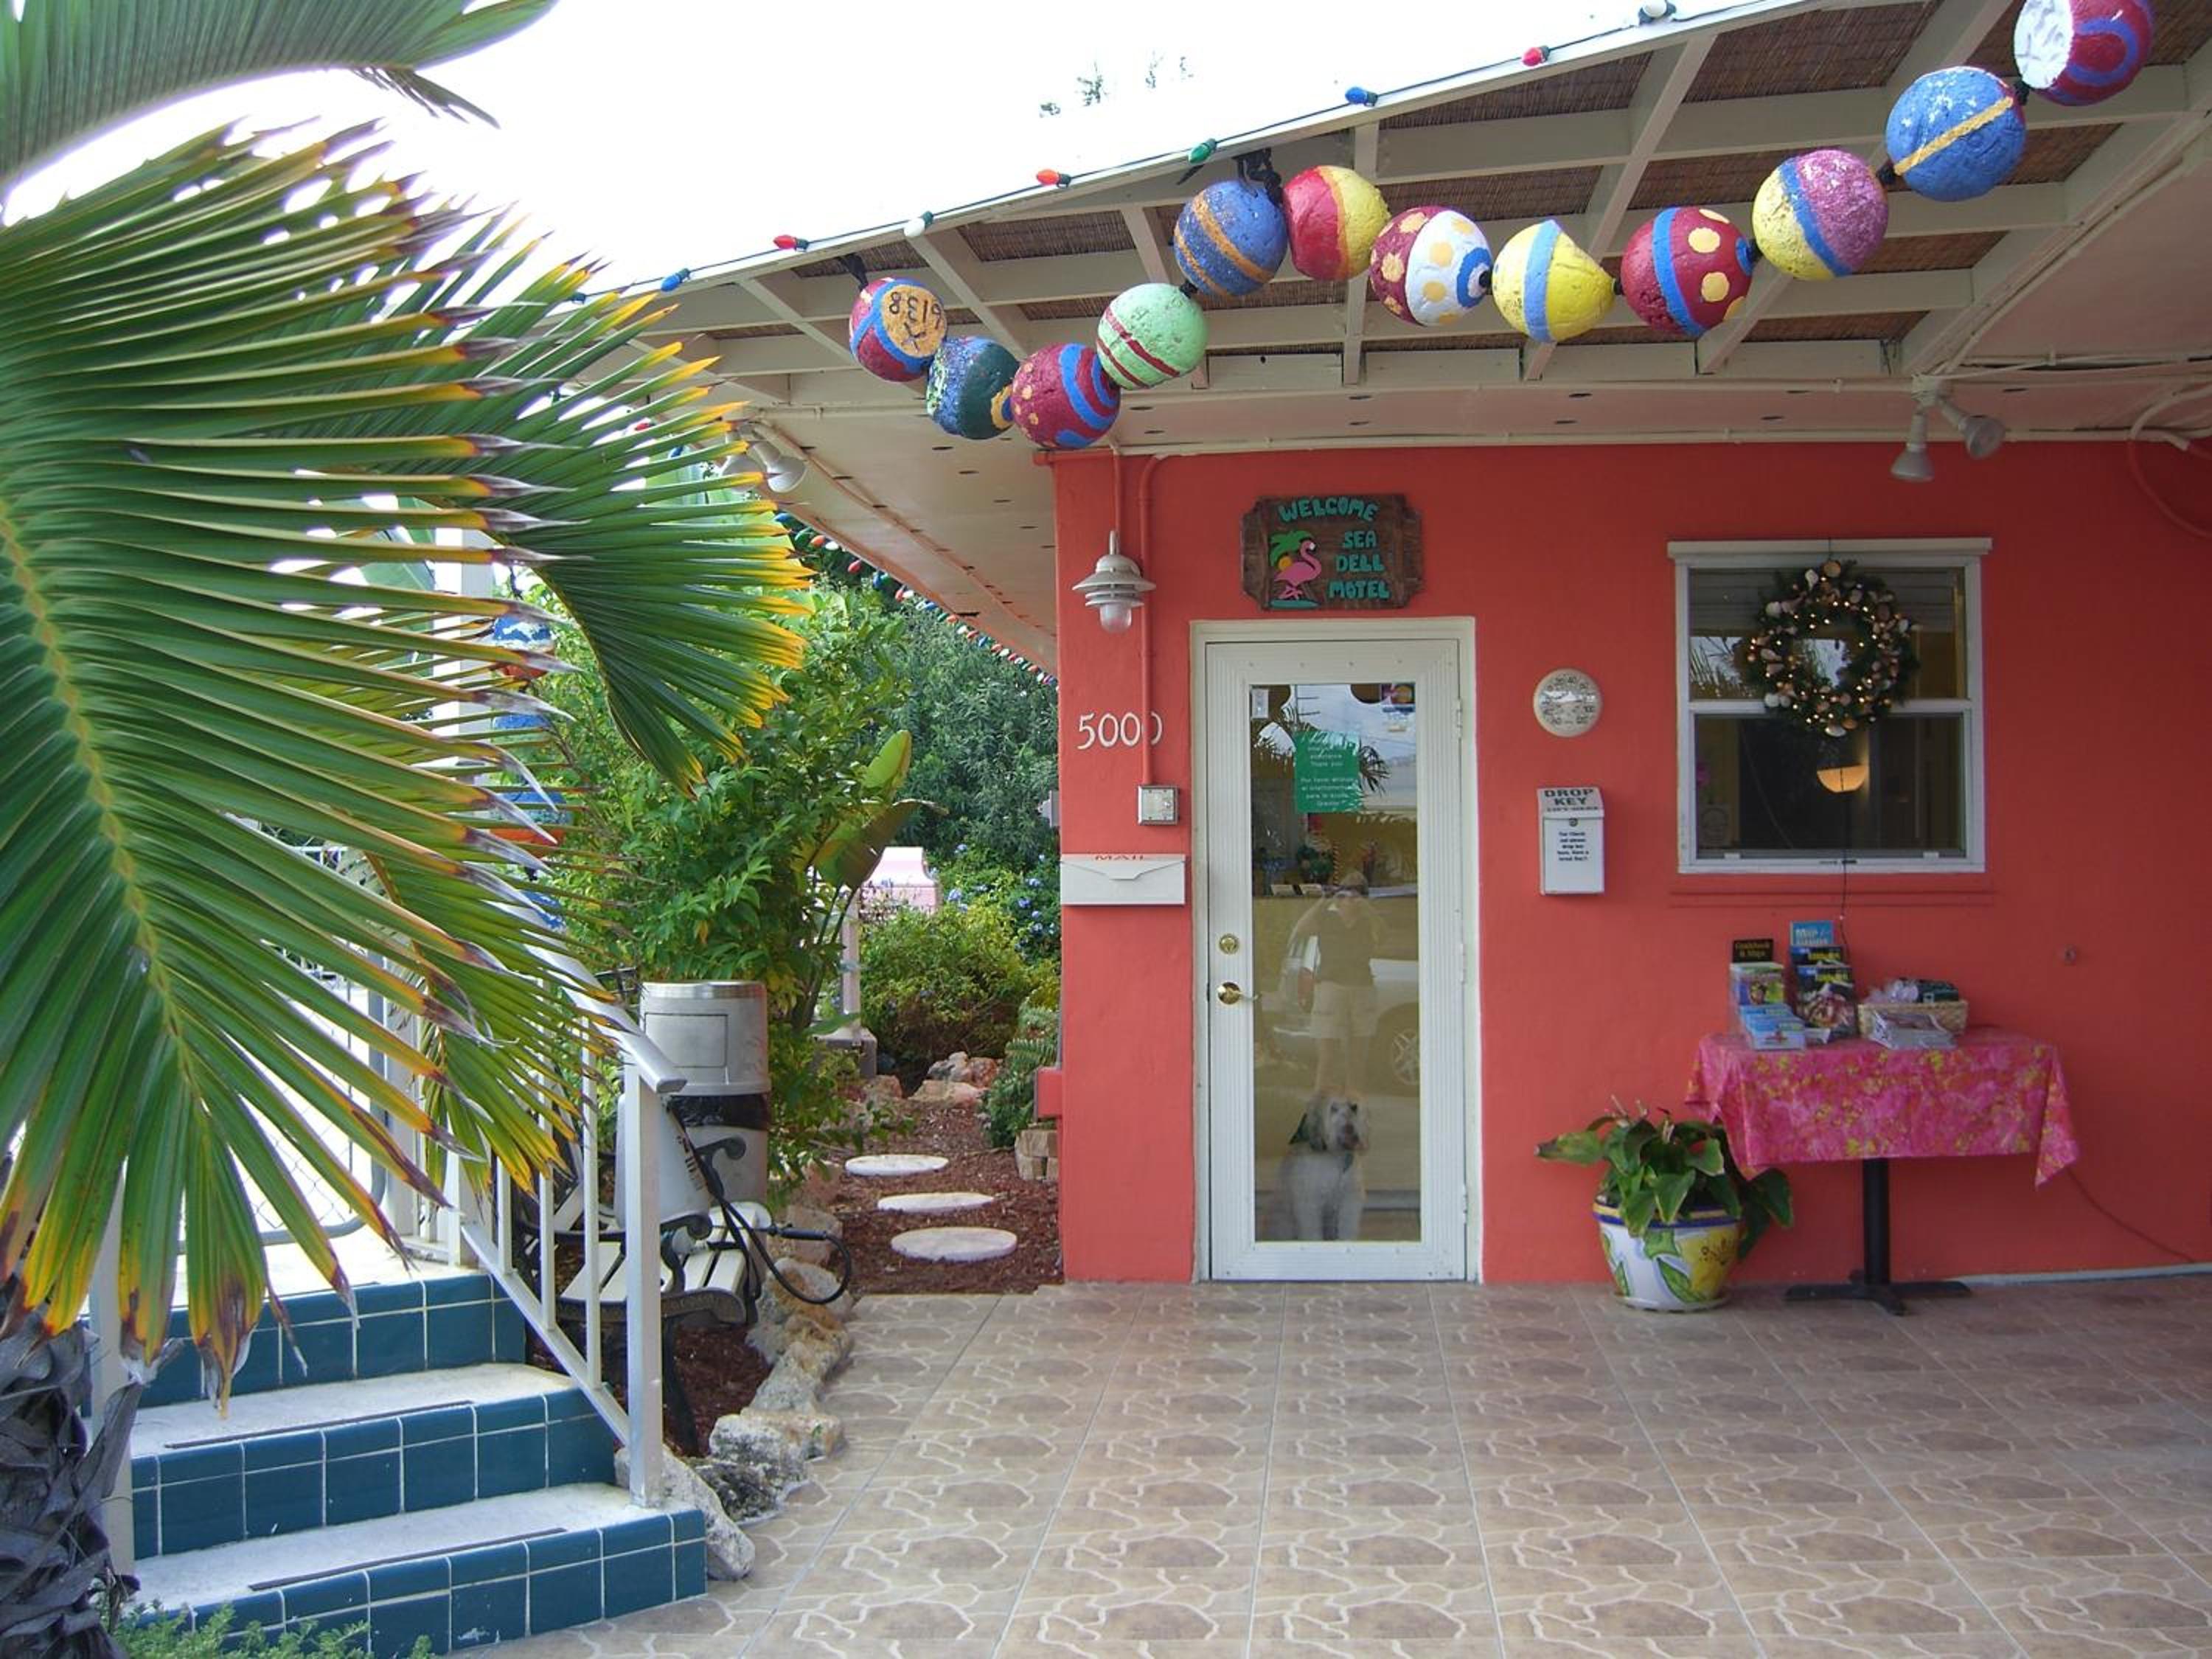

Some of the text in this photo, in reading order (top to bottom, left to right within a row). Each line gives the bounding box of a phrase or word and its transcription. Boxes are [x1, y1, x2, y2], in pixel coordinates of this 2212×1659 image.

[1278, 496, 1379, 523] WELCOME
[1343, 529, 1377, 549] SEA
[1335, 554, 1385, 573] DELL
[1328, 580, 1391, 600] MOTEL
[1545, 788, 1593, 797] DROP
[1554, 797, 1587, 805] KEY
